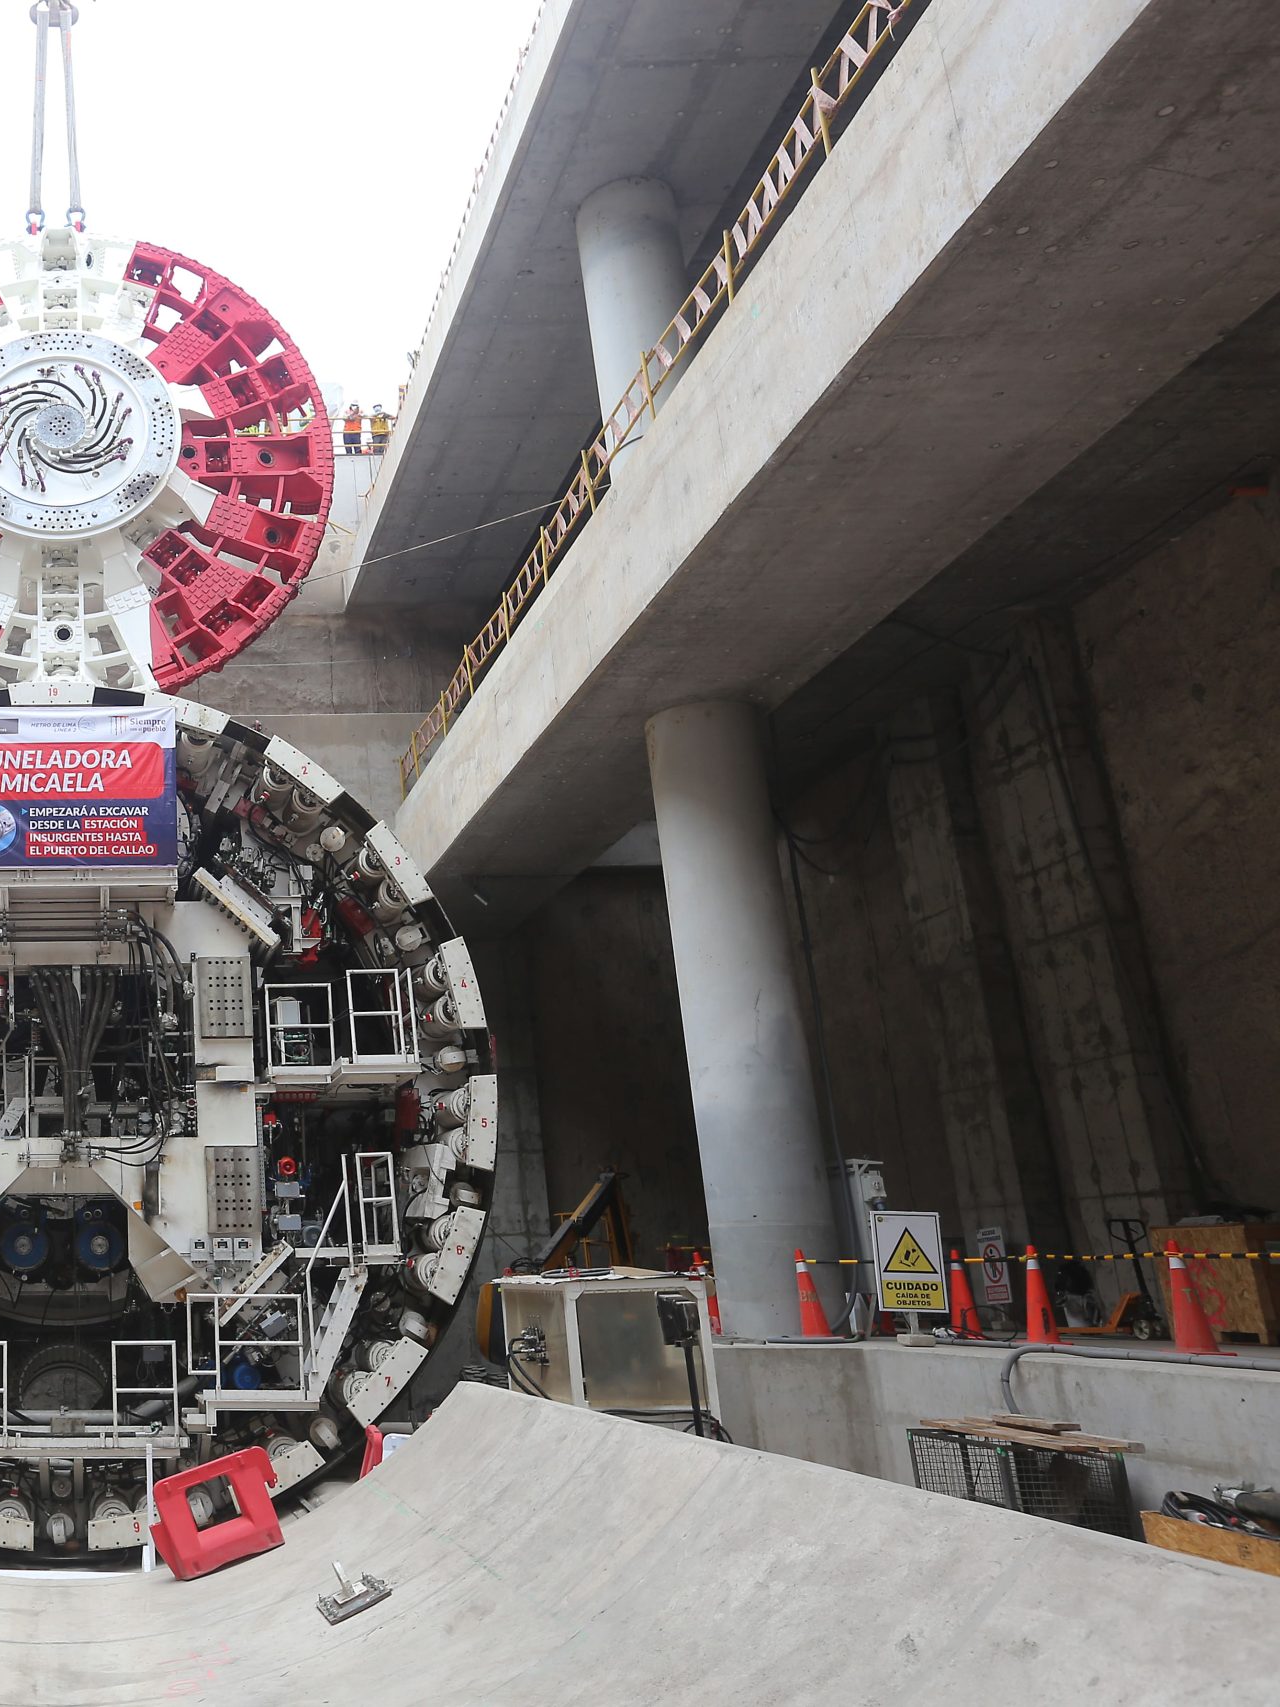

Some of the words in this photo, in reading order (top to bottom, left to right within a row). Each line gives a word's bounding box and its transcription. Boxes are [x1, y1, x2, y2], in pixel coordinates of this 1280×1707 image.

[48, 687, 58, 697] 19
[130, 717, 166, 727] Siempre
[301, 765, 308, 775] 2
[0, 772, 105, 793] MICAELA
[29, 804, 88, 817] EMPEZARÁ
[89, 807, 98, 816] A
[100, 806, 149, 816] EXCAVAR
[29, 820, 65, 830] DESDE
[66, 820, 80, 829] LA
[84, 817, 138, 829] ESTACIÓN
[29, 832, 104, 843] INSURGENTES
[106, 832, 142, 842] HASTA
[29, 846, 42, 855] EL
[43, 845, 87, 855] PUERTO
[89, 845, 110, 855] DEL
[111, 845, 155, 855] CALLAO
[395, 856, 401, 866] 3
[461, 979, 467, 988] 4
[481, 1117, 488, 1128] 5
[456, 1244, 463, 1255] 6
[886, 1281, 939, 1291] CUIDADO
[896, 1299, 932, 1307] OBJETOS
[384, 1376, 391, 1387] 7
[133, 1521, 140, 1533] 9
